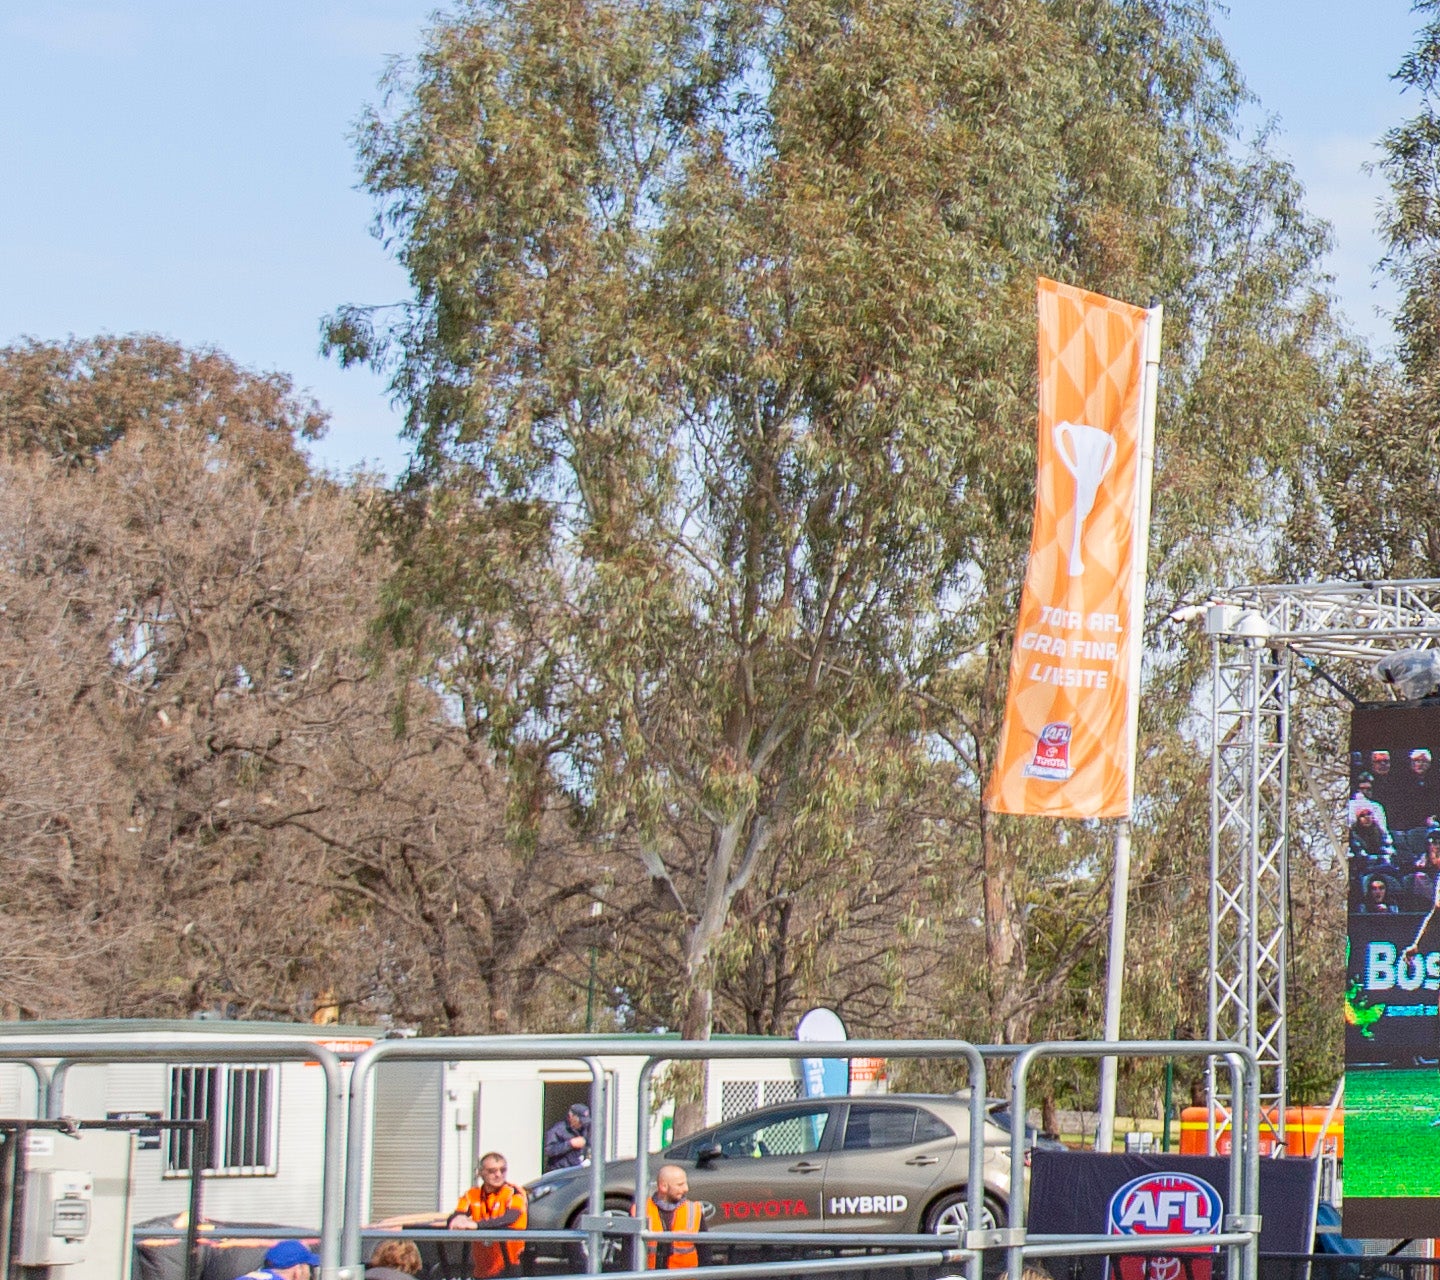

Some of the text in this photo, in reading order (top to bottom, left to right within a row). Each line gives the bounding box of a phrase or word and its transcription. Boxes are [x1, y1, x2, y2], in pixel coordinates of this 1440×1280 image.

[1087, 612, 1123, 633] AFL
[721, 1195, 908, 1219] TOYOTA HYBRID
[1119, 1190, 1212, 1228] AFL
